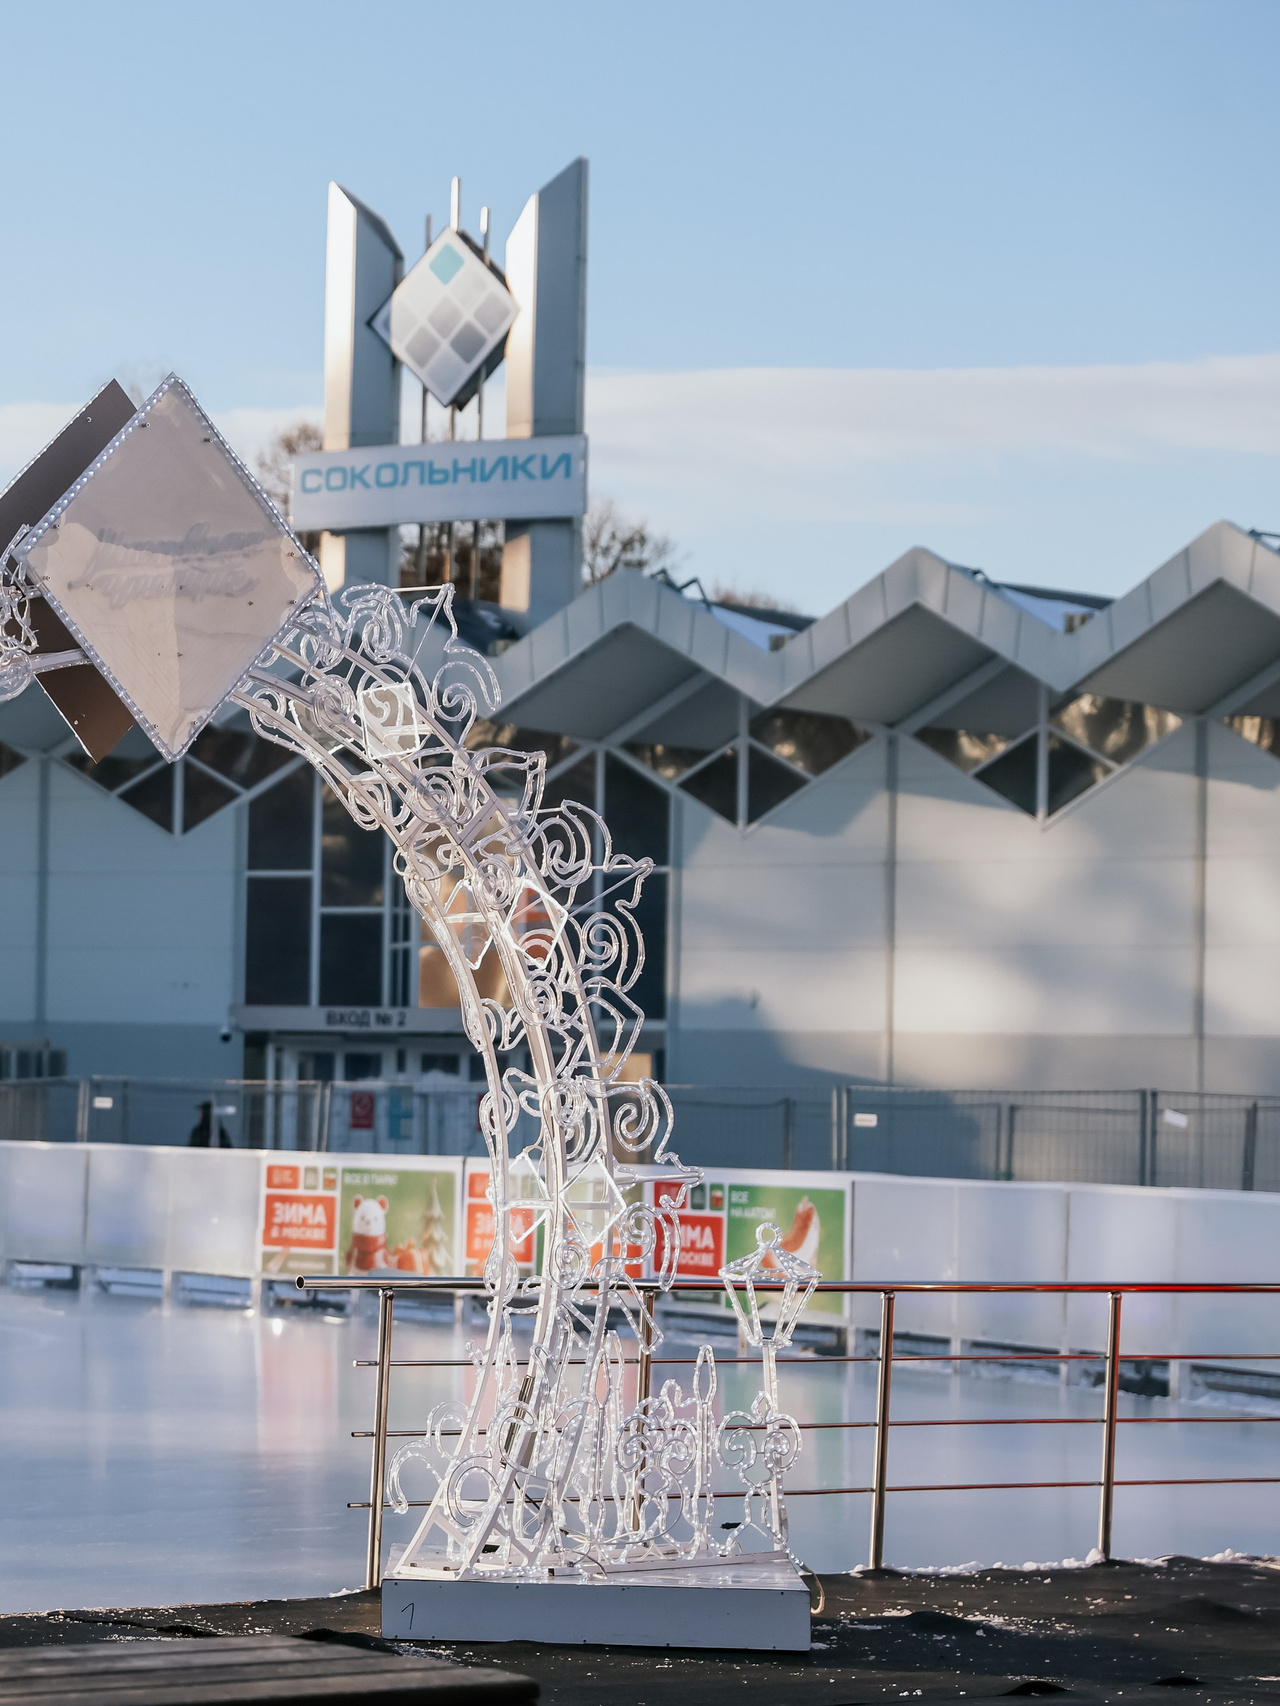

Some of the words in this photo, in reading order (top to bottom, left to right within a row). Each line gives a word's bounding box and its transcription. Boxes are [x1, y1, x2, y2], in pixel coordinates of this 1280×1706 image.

[300, 453, 572, 494] СОКОЛЬНИКИ
[326, 1010, 371, 1027] ВХОД
[397, 1010, 407, 1026] 2
[272, 1201, 327, 1225] ЗИМА
